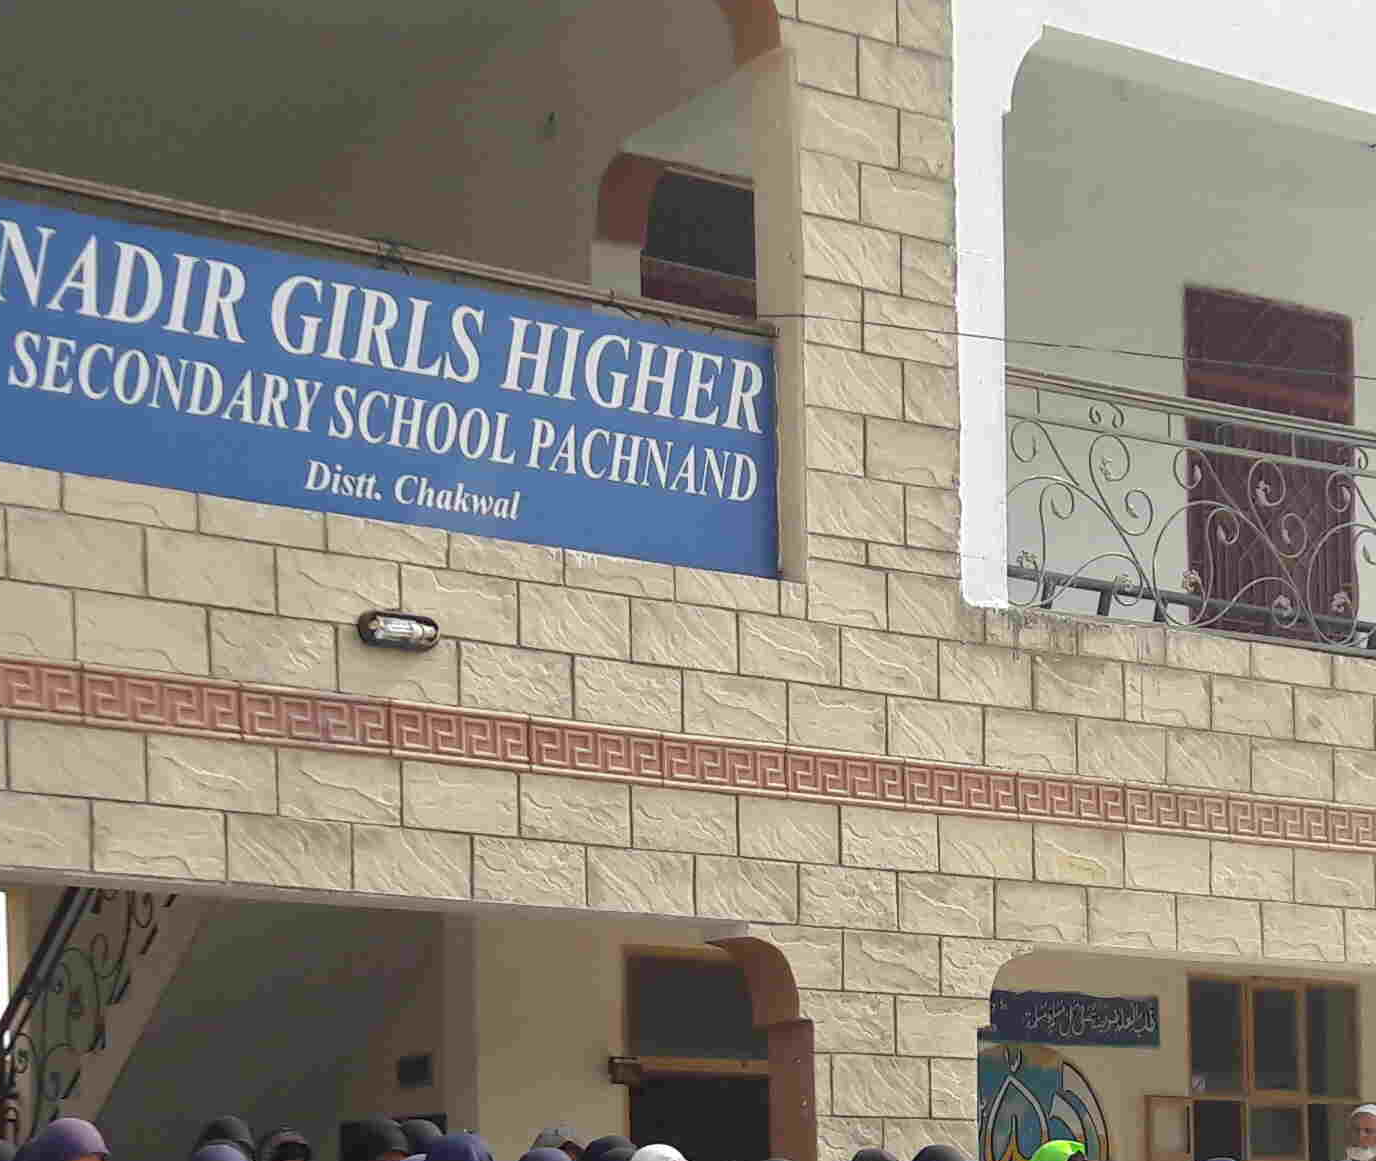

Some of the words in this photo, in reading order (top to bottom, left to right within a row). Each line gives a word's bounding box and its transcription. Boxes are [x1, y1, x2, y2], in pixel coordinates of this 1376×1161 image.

[7, 331, 323, 434] SECONDARY
[328, 385, 516, 465] SCHOOL
[526, 418, 758, 503] PACHNAND
[270, 273, 486, 385] GIRLS
[500, 316, 764, 435] HIGHER
[304, 459, 382, 501] Distt.
[393, 473, 521, 522] Chakwal
